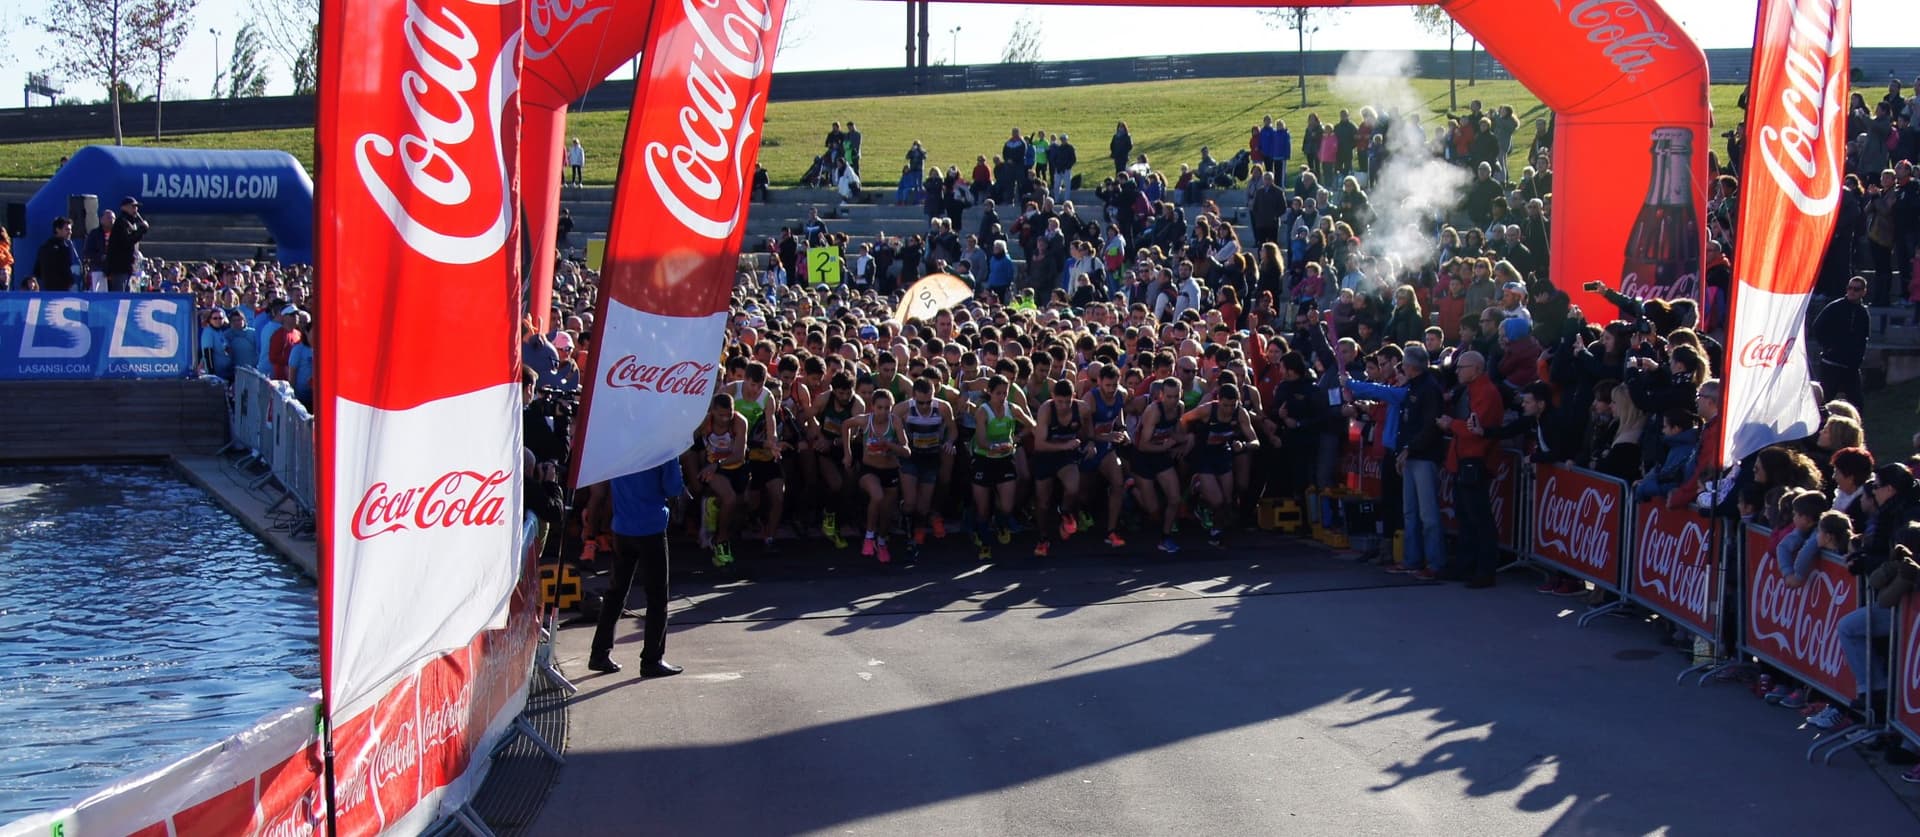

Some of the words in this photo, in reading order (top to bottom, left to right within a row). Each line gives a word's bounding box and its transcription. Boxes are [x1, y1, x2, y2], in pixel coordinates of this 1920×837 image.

[1569, 0, 1680, 73] Cola
[141, 173, 278, 199] LASANSI.COM
[18, 364, 91, 374] LASANSI.COM
[108, 363, 179, 373] LASANSI.COM
[606, 354, 715, 395] Coca-Cola
[351, 470, 512, 541] Coca-Cola
